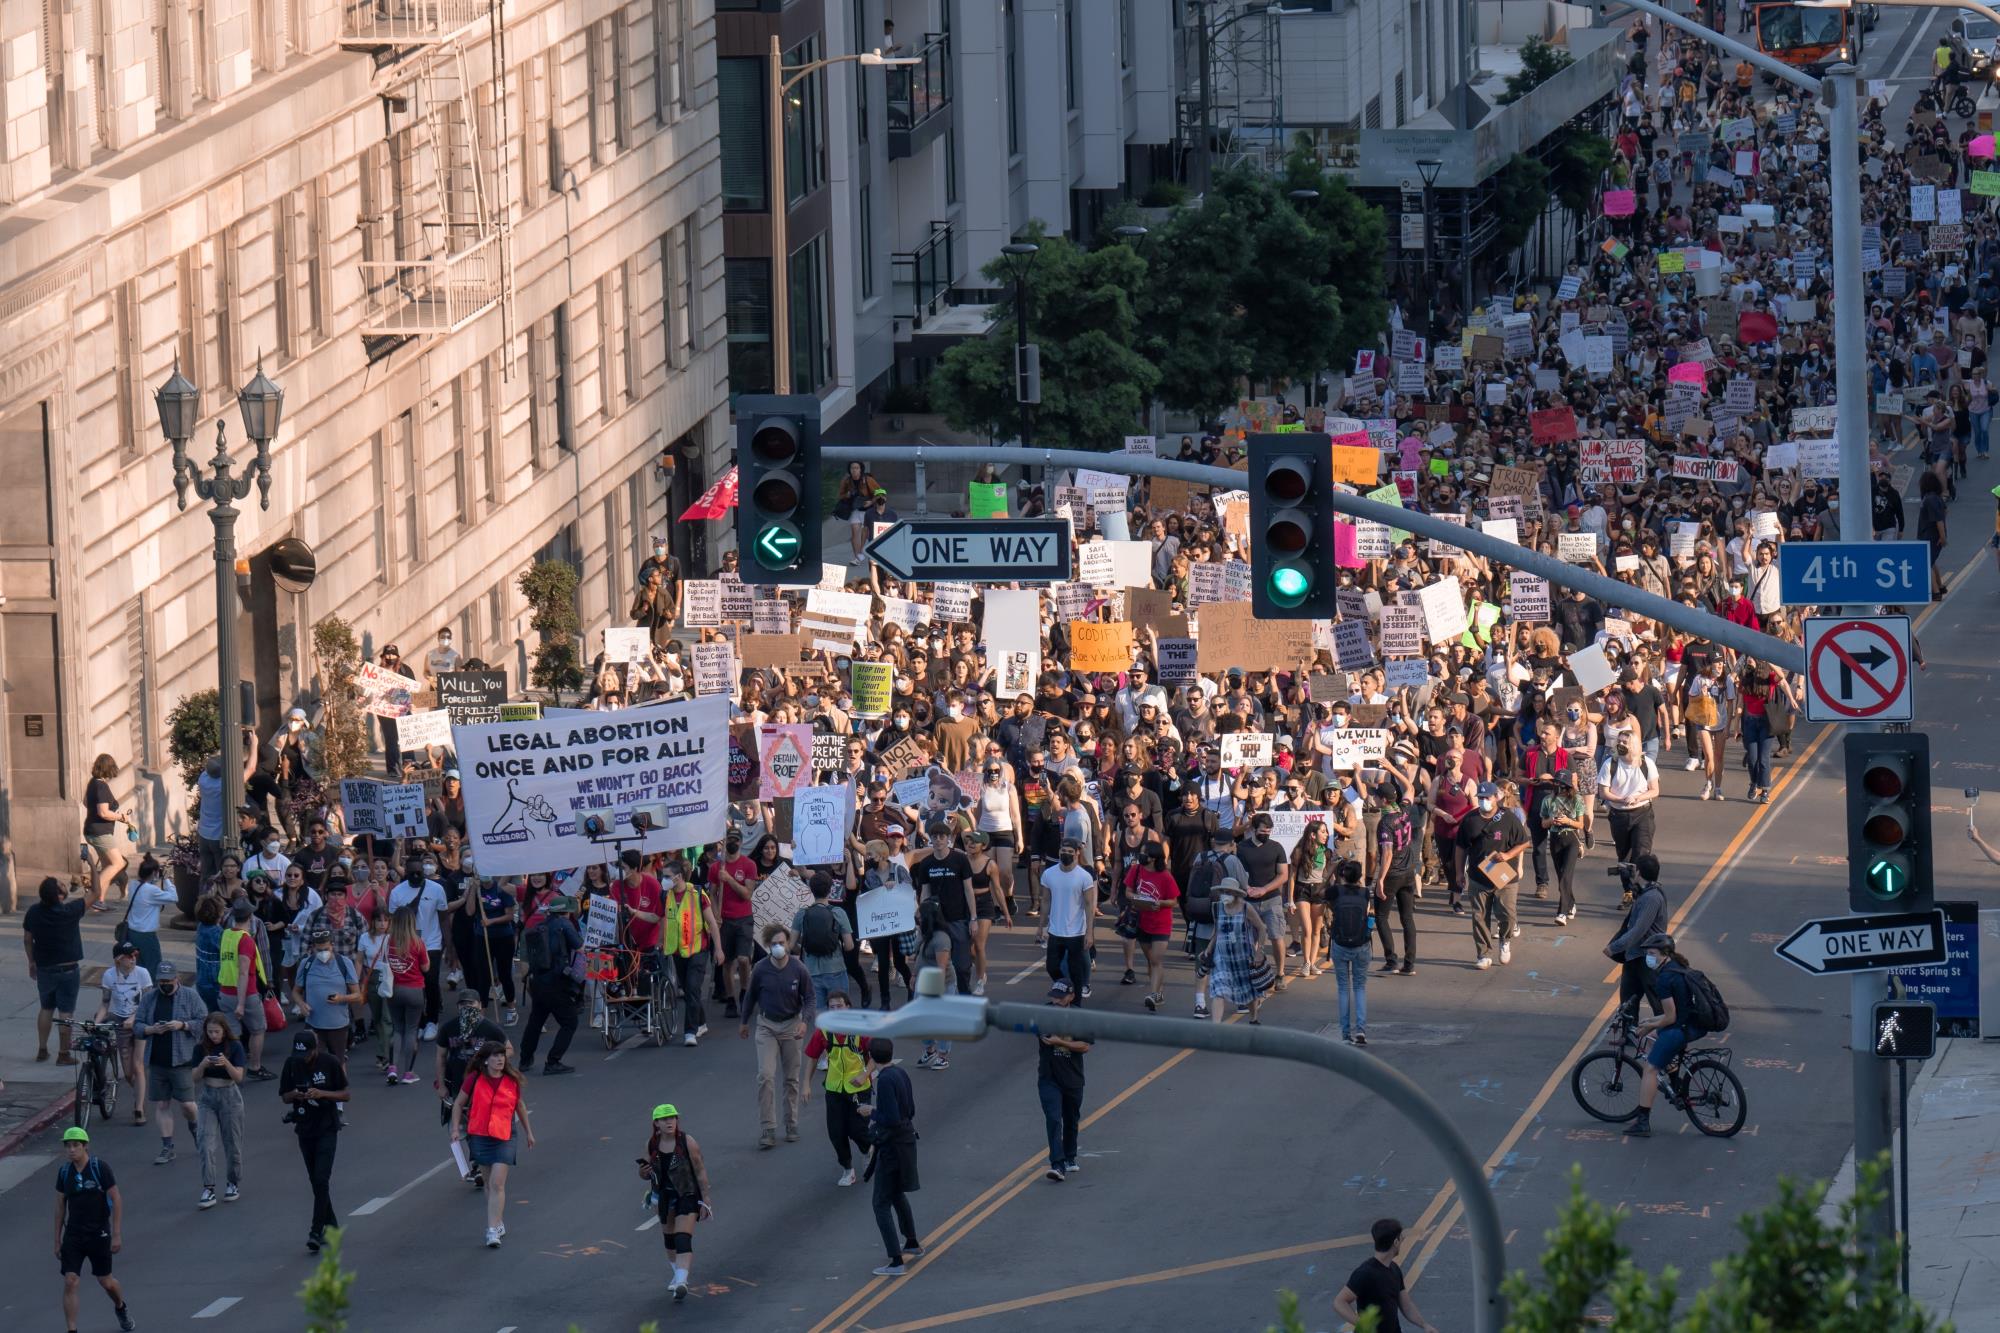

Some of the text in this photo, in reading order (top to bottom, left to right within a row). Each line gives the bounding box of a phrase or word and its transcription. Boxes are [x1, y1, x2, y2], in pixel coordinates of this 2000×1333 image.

[1497, 468, 1537, 489] TRUST
[1493, 482, 1535, 497] WOMEN
[1491, 499, 1520, 508] ABOLISH
[1497, 506, 1516, 515] THE
[912, 536, 1050, 564] ONE WAY
[1088, 545, 1106, 553] SAFE
[1086, 552, 1109, 560] LEGAL
[1083, 558, 1112, 566] ABORTION
[1801, 555, 1913, 592] 4th St
[1195, 577, 1213, 585] Enemy
[727, 585, 746, 593] THE
[936, 586, 970, 594] ABORTION
[1057, 584, 1092, 592] ABORTION
[1520, 585, 1540, 593] THE
[935, 597, 969, 606] ONCE AND
[1190, 594, 1222, 602] Fight Back!
[1337, 595, 1364, 604] ABOLISH
[721, 603, 753, 611] COURT!
[935, 604, 968, 614] FOR ALL!
[1345, 602, 1361, 611] THE
[1514, 604, 1547, 612] COURT!
[687, 612, 702, 620] Fight
[1330, 623, 1359, 635] DEFEND
[1390, 621, 1419, 629] SEXIST!
[1078, 627, 1122, 641] CODIFY
[1336, 632, 1356, 641] ROE!
[1335, 638, 1362, 649] BY ANY
[1383, 640, 1420, 648] SOCIALISM!
[1071, 645, 1088, 662] Roe
[1167, 651, 1188, 659] THE
[1340, 648, 1363, 658] MEANS
[362, 665, 378, 679] No
[441, 677, 481, 693] WILL
[698, 680, 714, 689] Fight
[447, 705, 500, 716] STERILIZE
[501, 705, 537, 717] OVERTURN
[451, 716, 463, 726] US
[466, 716, 500, 726] NEXT?
[487, 716, 689, 754] LEGAL ABORTION
[1336, 730, 1382, 740] WE WILL
[830, 735, 847, 746] THE
[883, 738, 912, 762] NOT
[1336, 746, 1382, 756] GO BACK
[475, 736, 706, 779] ONCE AND FOR ALL!
[773, 754, 799, 763] RETAIN
[811, 758, 844, 769] COURT
[773, 764, 799, 779] ROE
[577, 760, 703, 794] WE WON'T GO BACK
[345, 783, 356, 791] WE
[569, 778, 702, 810] WE WILL FIGHT BACK!
[349, 796, 360, 804] WE
[354, 809, 376, 818] FIGHT
[1305, 813, 1326, 823] NOT
[353, 818, 378, 828] BACK!
[591, 899, 617, 914] LEGALIZE
[590, 911, 616, 924] ABORTION
[871, 911, 899, 922] AMERICA
[587, 926, 613, 940] ONCE AND
[586, 936, 599, 946] FOR
[1826, 928, 1925, 956] ONE WAY
[1919, 967, 1961, 977] Spring St
[1921, 984, 1950, 994] Square
